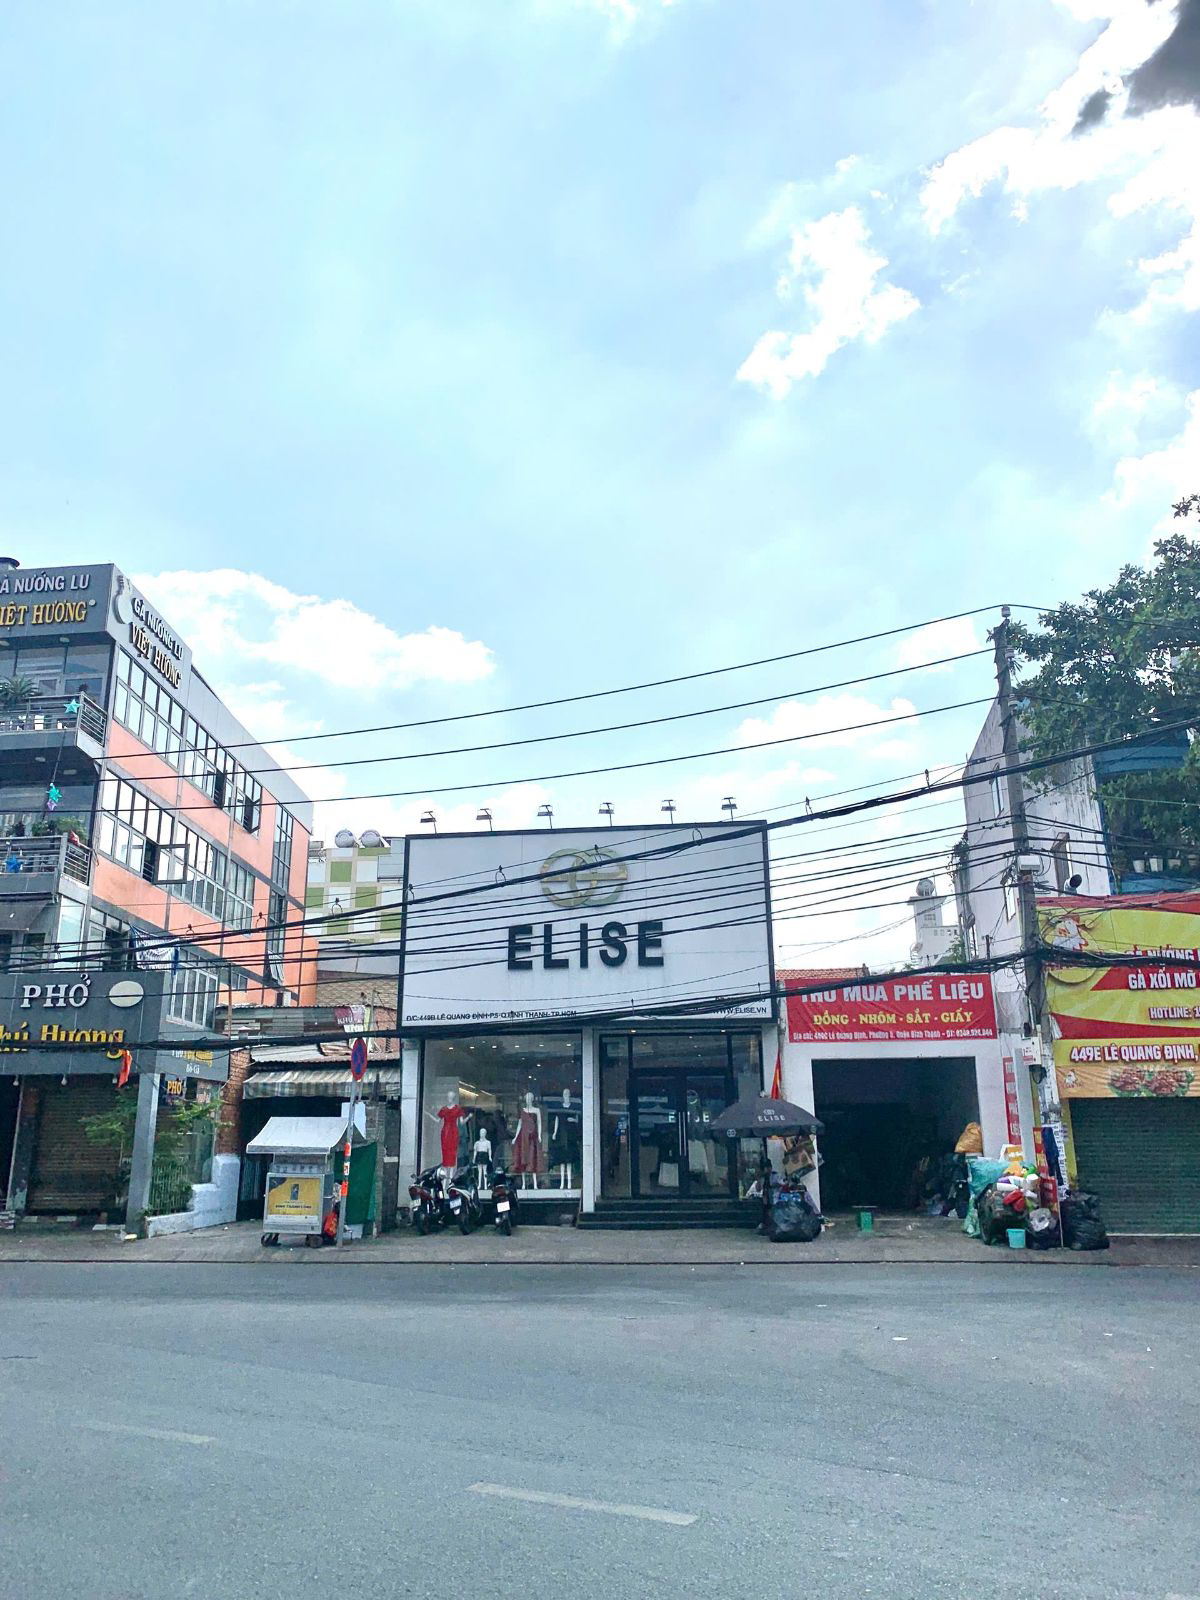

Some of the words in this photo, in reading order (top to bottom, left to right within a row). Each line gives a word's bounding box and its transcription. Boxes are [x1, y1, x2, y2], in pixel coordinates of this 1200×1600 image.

[0, 574, 9, 594] À
[14, 571, 65, 593] NƯỚNG
[70, 574, 91, 590] LU
[0, 601, 28, 631] IỆT
[32, 600, 87, 625] HƯƠNG
[131, 621, 153, 659] VIỆT
[174, 640, 184, 660] LU
[507, 920, 665, 970] ELISE
[1128, 969, 1147, 990] GÀ
[1149, 965, 1172, 989] XỐI
[20, 973, 91, 1008] PHỞ
[843, 984, 888, 1001] MUA
[893, 979, 934, 1001] PHẾ
[940, 980, 984, 1003] LIỆU
[859, 1010, 897, 1024] NHÔM
[940, 1007, 973, 1023] GIẤY
[1149, 1006, 1193, 1019] HOTLINE:
[0, 1021, 29, 1052] hú
[1071, 1045, 1102, 1061] 449E
[1104, 1042, 1119, 1061] LÊ
[1120, 1043, 1161, 1062] QUANG
[1163, 1043, 1199, 1063] ĐỊNH,
